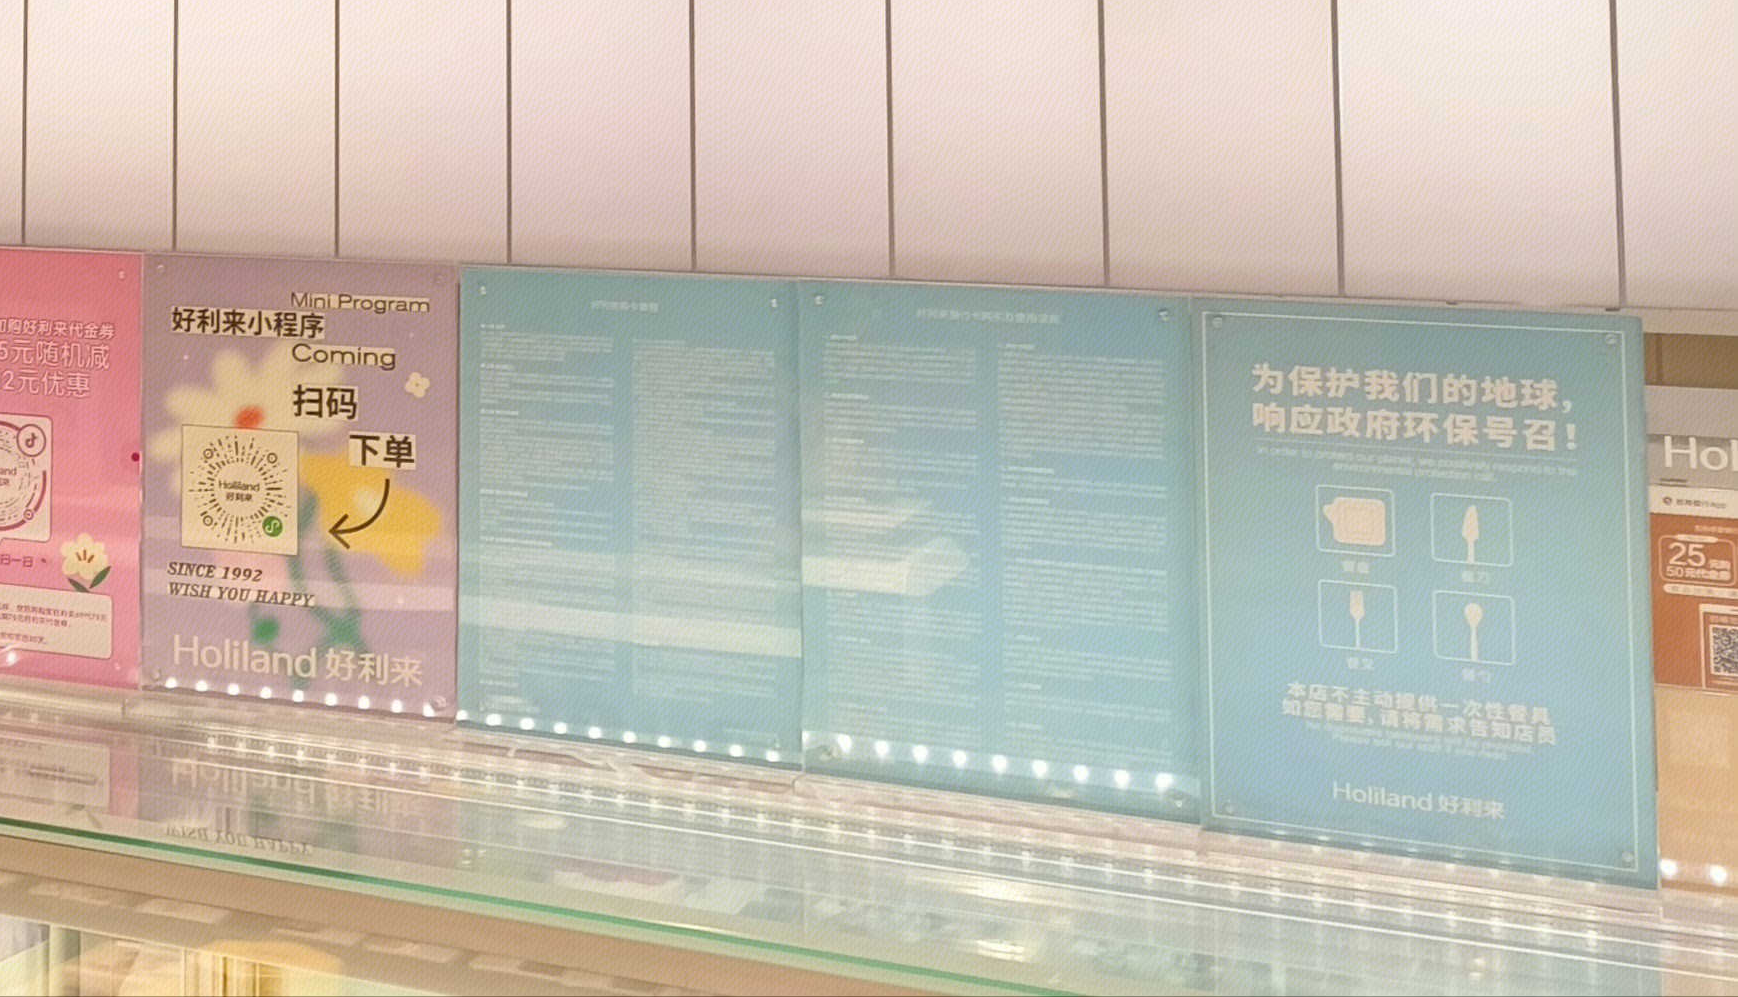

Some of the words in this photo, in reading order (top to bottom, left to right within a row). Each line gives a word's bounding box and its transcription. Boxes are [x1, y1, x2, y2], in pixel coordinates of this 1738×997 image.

[290, 292, 334, 309] Mini
[338, 293, 431, 315] Program
[171, 306, 325, 339] 好利来小程序
[292, 343, 397, 371] Coming
[292, 384, 358, 420] 扫码
[349, 433, 415, 468] 下单
[218, 480, 261, 493] Holiland
[166, 561, 216, 579] SINCE
[222, 567, 263, 582] 1992
[168, 581, 212, 599] WISH
[215, 587, 252, 602] YOU
[254, 591, 315, 608] HAPPY
[173, 633, 317, 678] Holiland
[325, 647, 423, 688] 好利来
[1332, 781, 1433, 812] Holiland
[1437, 793, 1506, 820] 好利来
